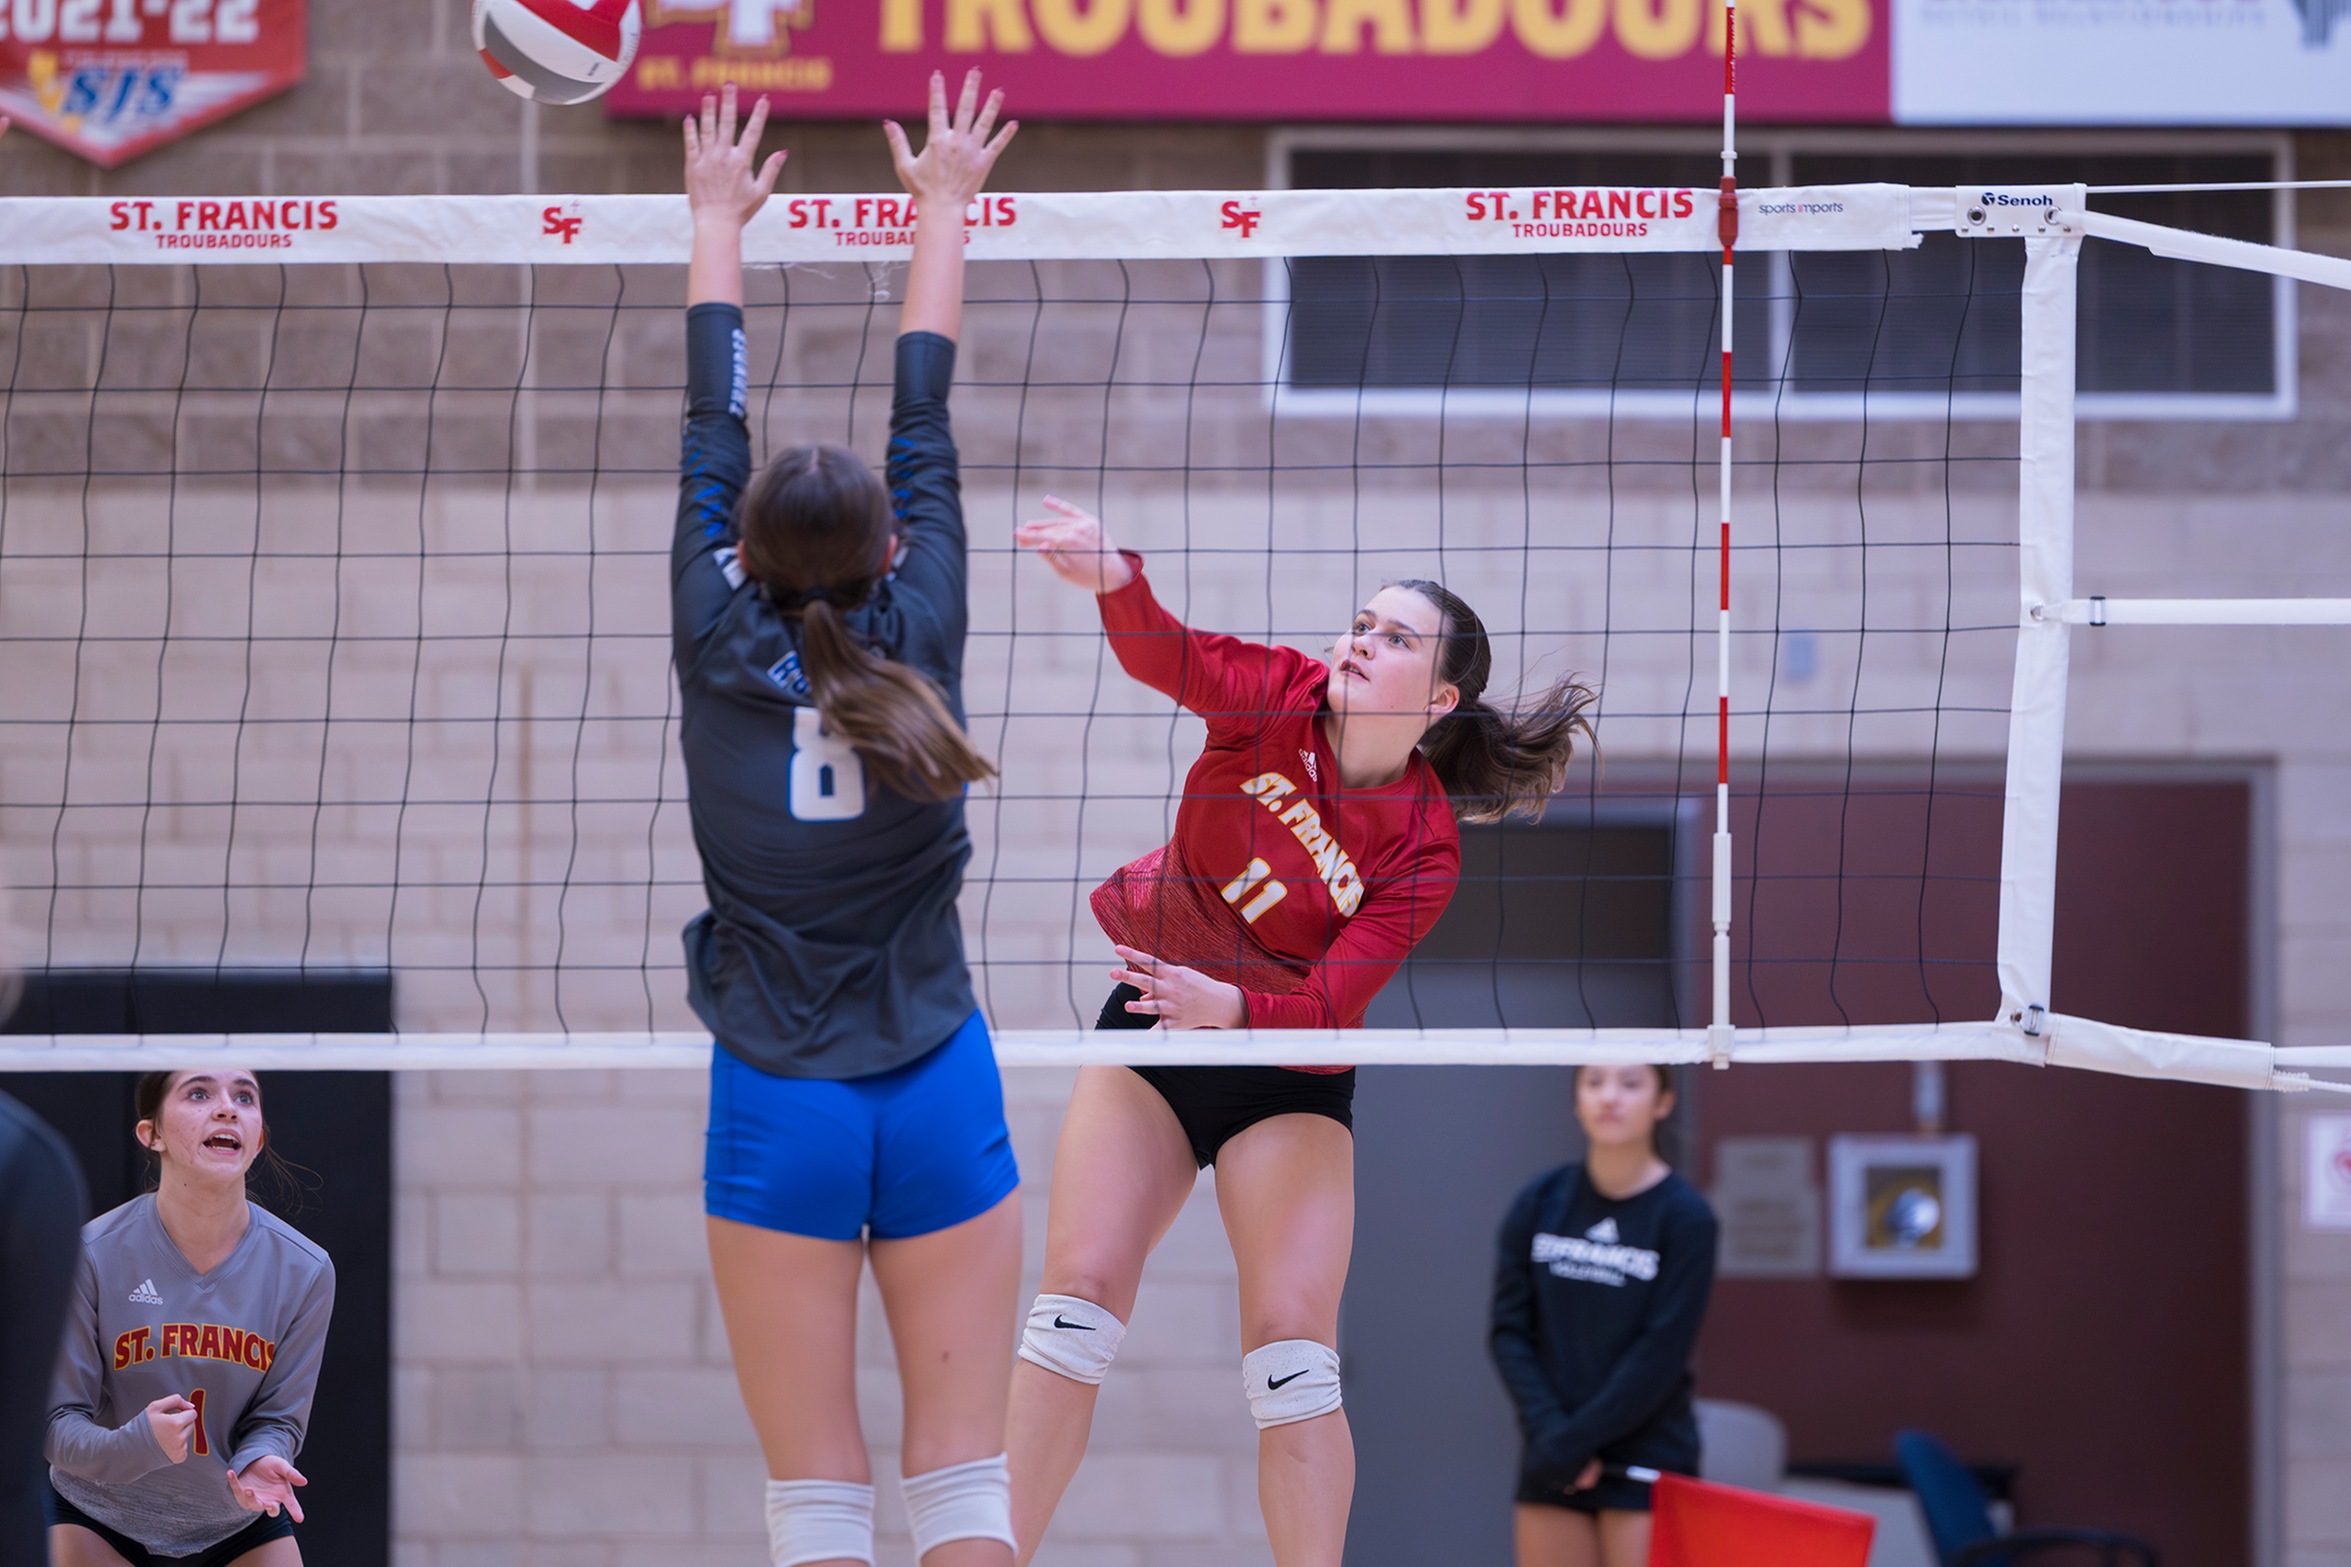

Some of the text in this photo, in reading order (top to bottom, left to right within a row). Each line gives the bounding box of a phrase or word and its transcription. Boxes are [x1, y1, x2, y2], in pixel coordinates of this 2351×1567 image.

[0, 0, 259, 43] 021-22
[110, 200, 338, 230] ST. FRANCIS
[789, 197, 1017, 228] ST. FRACIS
[1466, 190, 1693, 220] ST. FRANCIS
[1759, 203, 1796, 215] sports
[1997, 194, 2053, 206] Senoh
[156, 233, 292, 248] TROUBADOURS
[835, 231, 970, 246] TROUBAS
[1512, 223, 1647, 238] TROUBADOURS
[789, 705, 866, 822] 8
[1240, 772, 1365, 917] ST. FRANCIS
[1220, 857, 1287, 924] 11
[128, 1293, 163, 1305] adidas
[114, 1326, 154, 1370] ST.
[189, 1388, 209, 1456] 1
